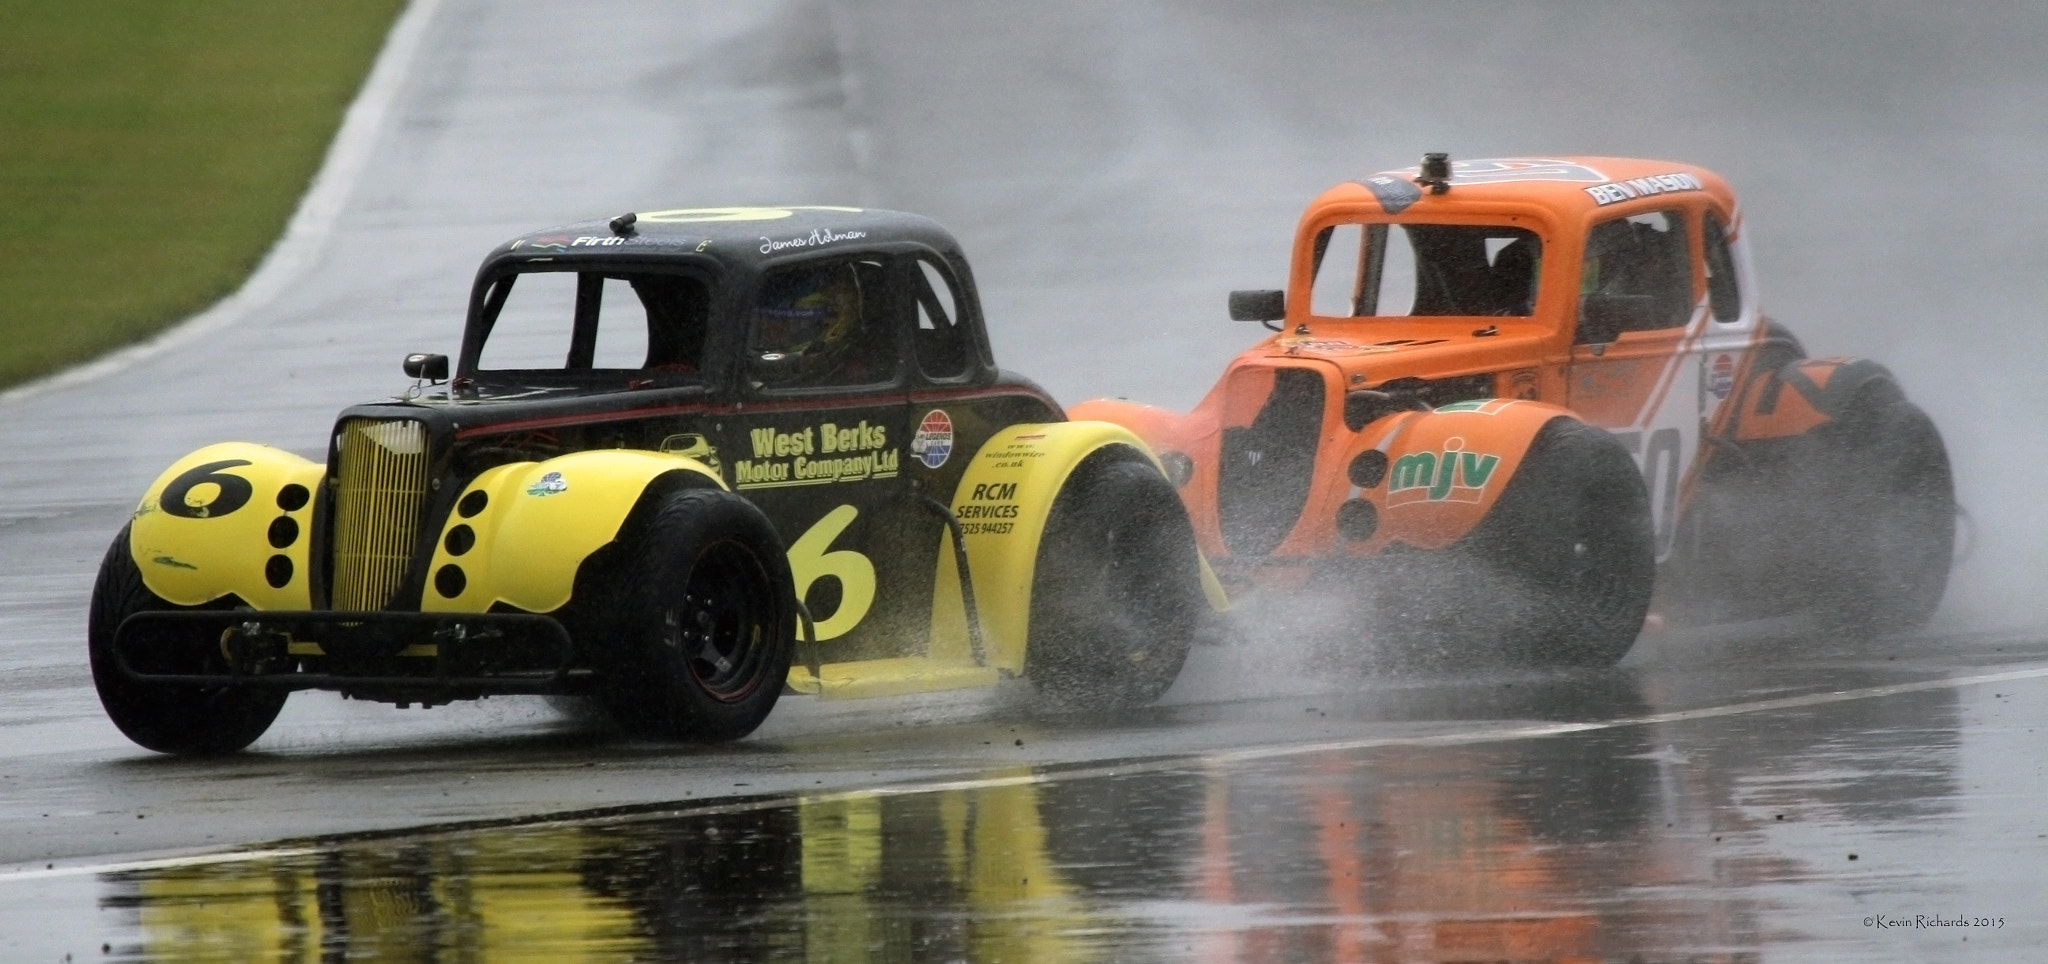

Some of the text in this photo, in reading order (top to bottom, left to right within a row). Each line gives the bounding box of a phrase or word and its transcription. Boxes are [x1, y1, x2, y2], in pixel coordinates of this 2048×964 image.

[1584, 173, 1702, 206] BEN MASON
[759, 228, 867, 254] James Holman
[751, 420, 886, 458] West Berks
[735, 460, 790, 484] Motor
[1388, 437, 1500, 501] mjv
[159, 459, 253, 518] 6
[972, 483, 1018, 501] RCM
[956, 505, 1019, 519] SERVICES
[981, 522, 1014, 535] 944257
[786, 504, 877, 642] 6
